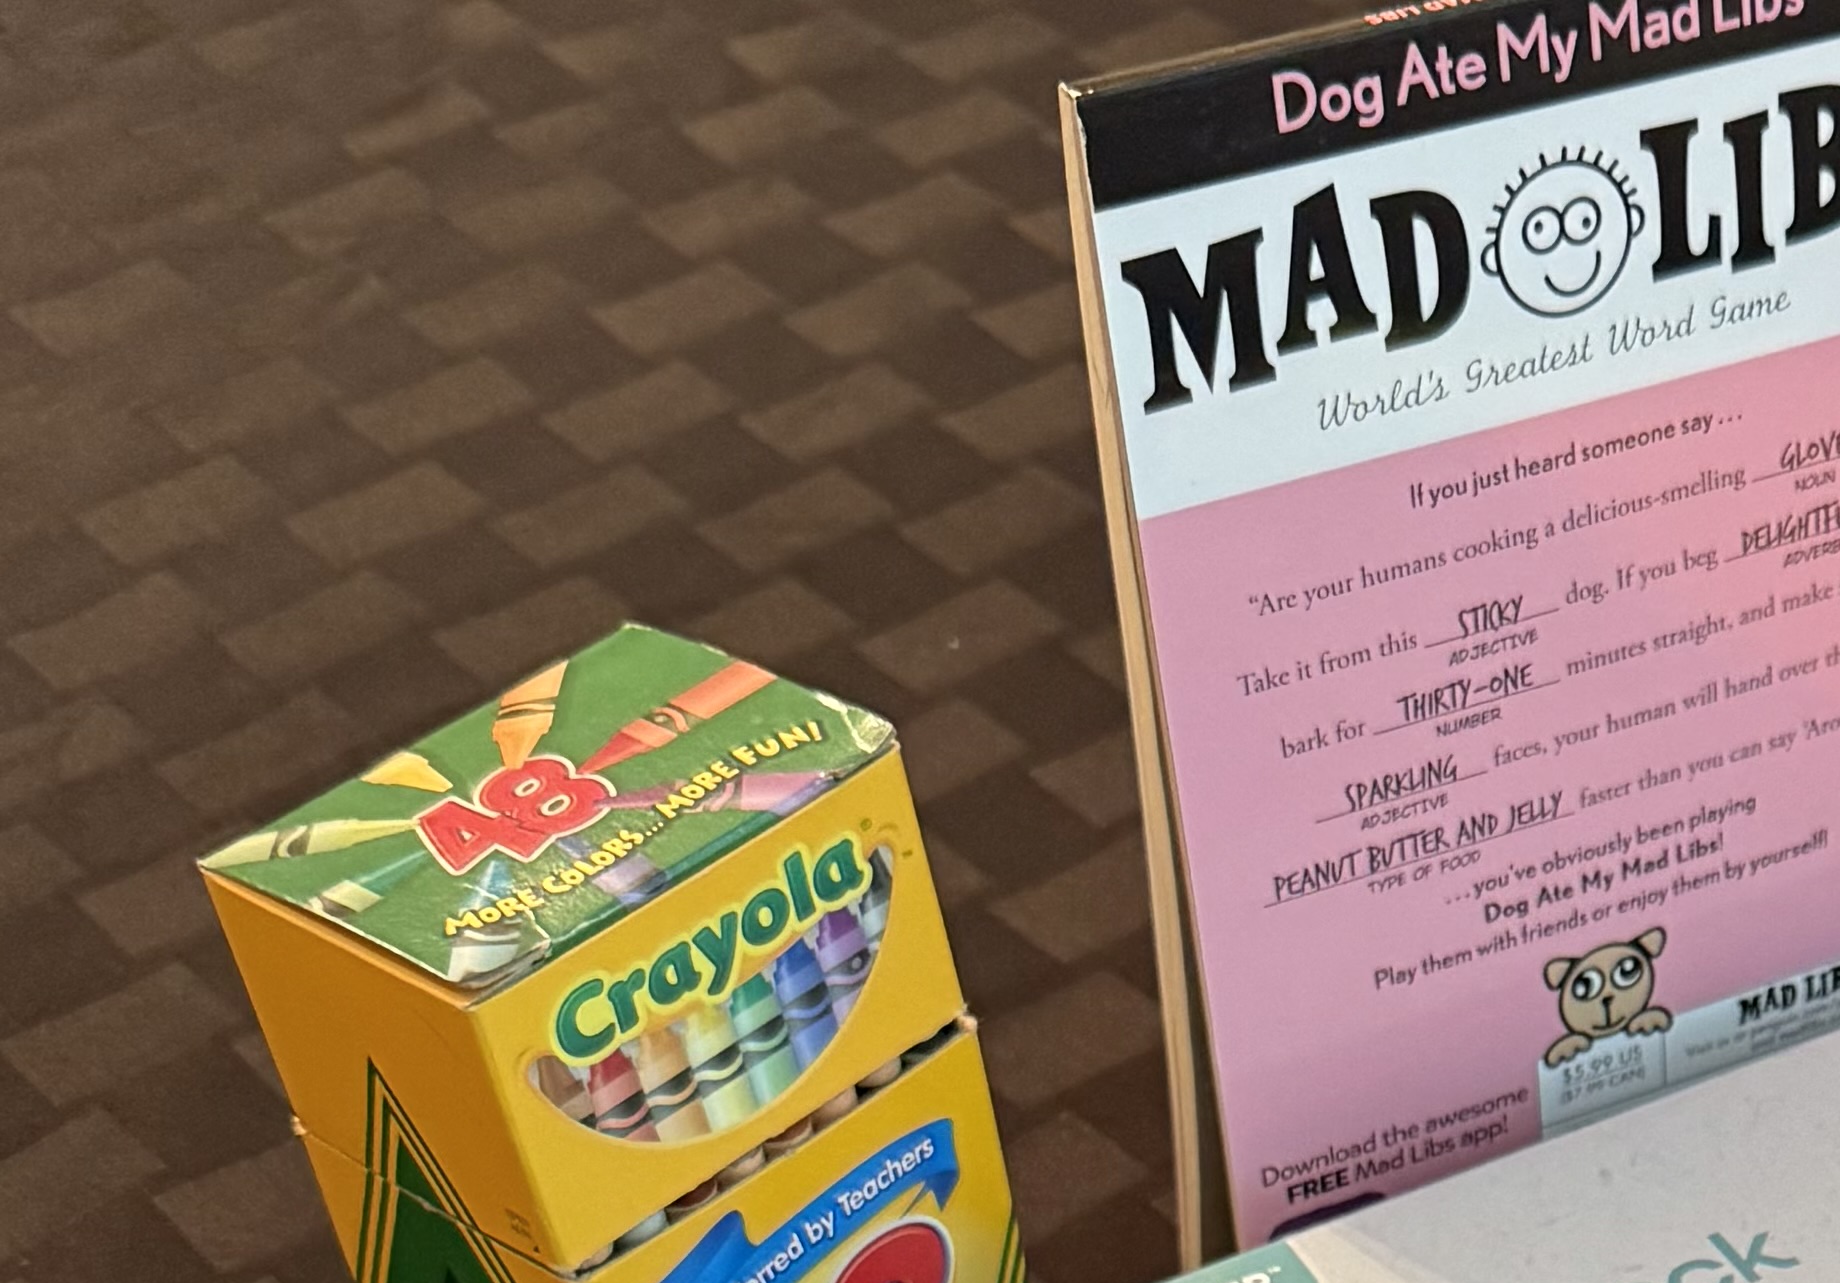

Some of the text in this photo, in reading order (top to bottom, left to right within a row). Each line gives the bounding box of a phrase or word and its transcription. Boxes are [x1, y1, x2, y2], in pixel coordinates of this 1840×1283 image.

[1270, 0, 1701, 136] Dog Ate My Mad
[1121, 184, 1471, 414] MAD
[1317, 288, 1792, 432] World's Greatest Word Game
[1410, 422, 1677, 509] If you just heard someone
[1794, 469, 1837, 492] NOUN
[1304, 576, 1355, 611] your
[1361, 553, 1447, 589] humans
[1453, 528, 1540, 565] cooking
[1562, 469, 1748, 534] delicious-smelling
[1236, 667, 1292, 697] Take
[1297, 661, 1313, 681] it
[1319, 649, 1372, 676] from
[1378, 631, 1419, 657] this
[1457, 595, 1523, 640] STICKY
[1565, 578, 1610, 606] dog.
[1616, 566, 1636, 591] If
[1638, 561, 1677, 591] you
[1682, 548, 1720, 573] beg
[1279, 583, 1835, 759] bark for THIRTY-ONE minutes straight, and make
[1449, 628, 1540, 667] ADJECTIVE
[1344, 754, 1458, 813] SPARKLING
[1553, 724, 1601, 757] your
[1605, 700, 1678, 735] human
[1682, 681, 1719, 711] will
[1723, 666, 1774, 700] hand
[1778, 656, 1819, 682] over
[1435, 706, 1504, 738] NUMBER
[414, 755, 614, 874] 48
[444, 887, 545, 938] MORE
[655, 756, 740, 820] MORE
[731, 720, 825, 767] FUN!
[1273, 741, 1763, 903] PEANUT BUTTER AND JELLY faster than you can
[1360, 792, 1449, 831] ADJECTIVE
[1541, 795, 1758, 876] obviously been playing
[1367, 849, 1482, 895] TYPE FOOD
[1373, 858, 1747, 991] Play them with friends enjoy them by
[1483, 849, 1669, 925] Dog Ate My Mad
[554, 836, 867, 1060] Crayola
[1738, 984, 1797, 1026] MAD
[804, 1210, 837, 1245] by
[836, 1134, 936, 1218] Teachers
[1261, 1086, 1530, 1189] Download the awesome
[1286, 1114, 1509, 1206] FREE Mad Libs app!
